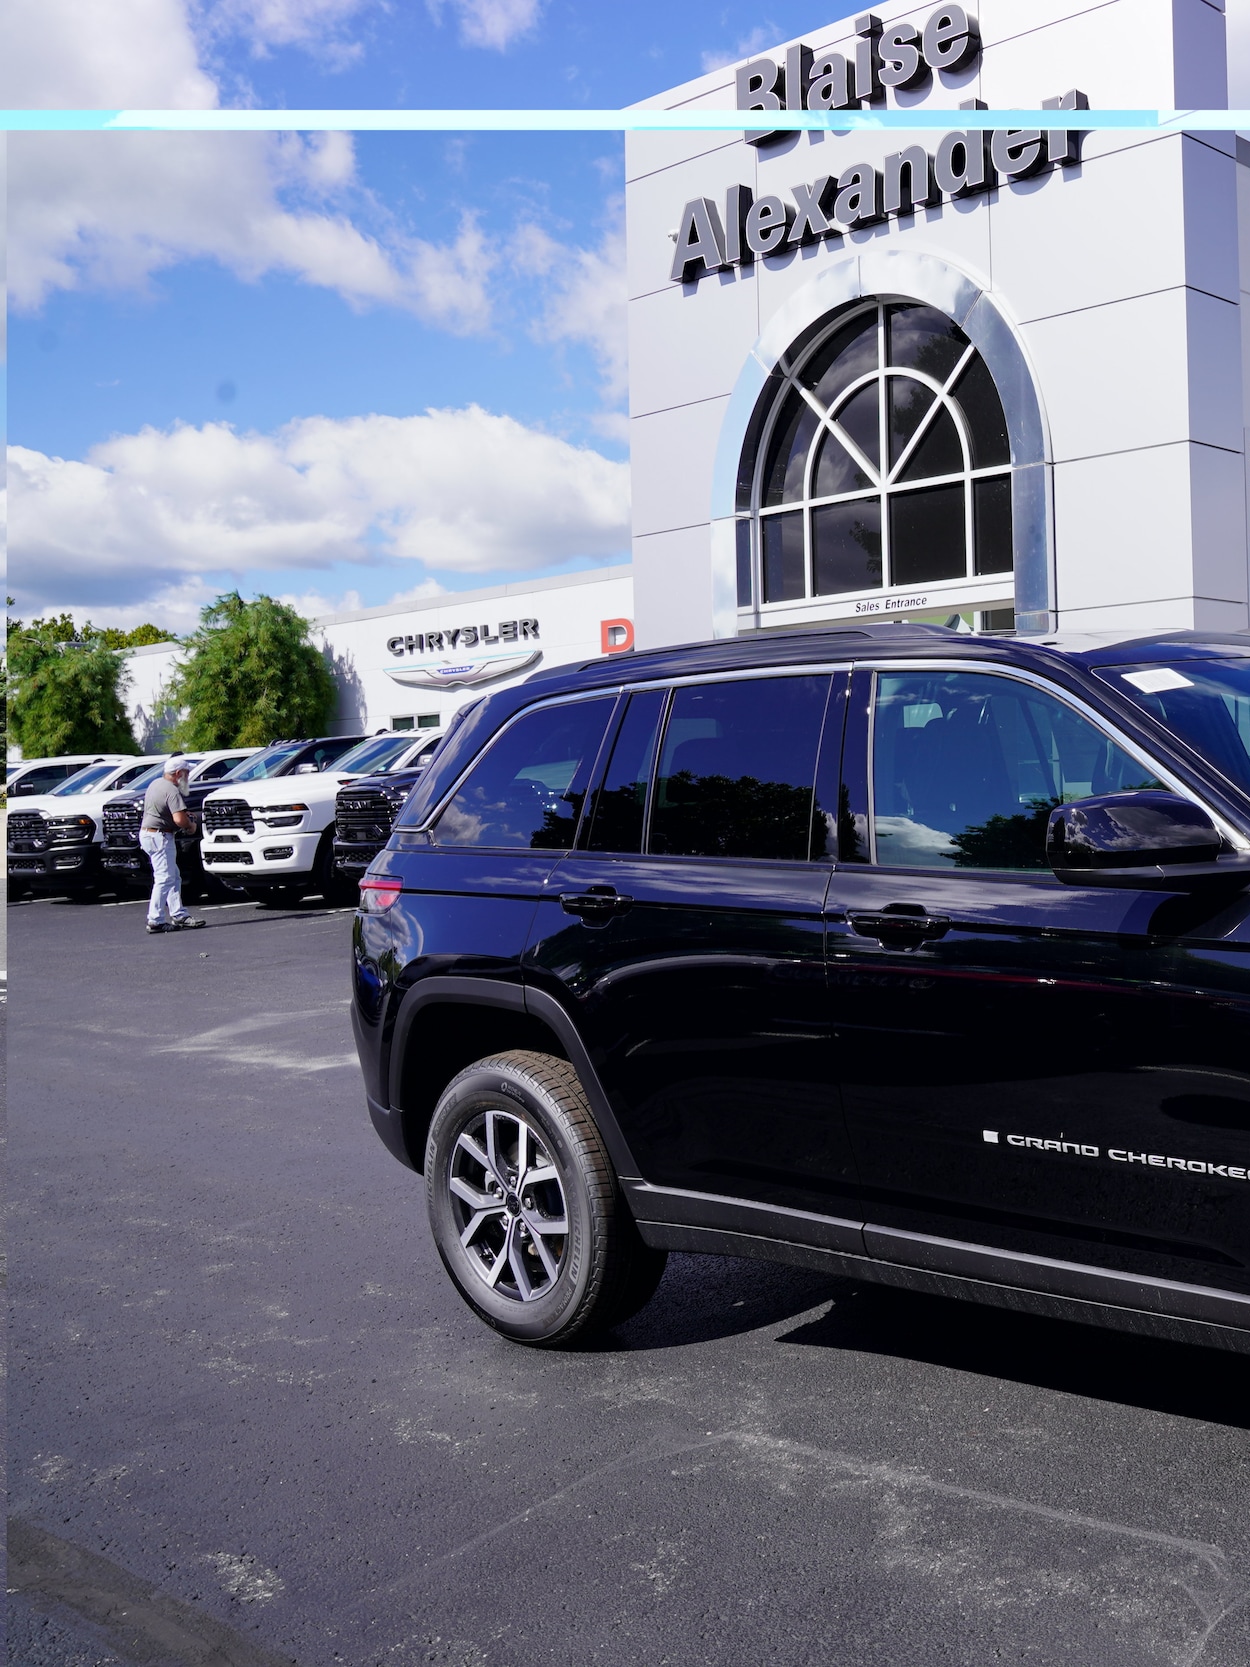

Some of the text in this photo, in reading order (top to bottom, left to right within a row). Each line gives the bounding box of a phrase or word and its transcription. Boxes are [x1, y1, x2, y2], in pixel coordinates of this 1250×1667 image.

[735, 2, 980, 146] Blaise
[670, 89, 1092, 283] Alexander
[855, 596, 928, 613] Sales Entrance
[387, 618, 540, 654] CHRYSLER
[439, 666, 471, 675] CHRYSLER
[1006, 1133, 1100, 1158] GRAND
